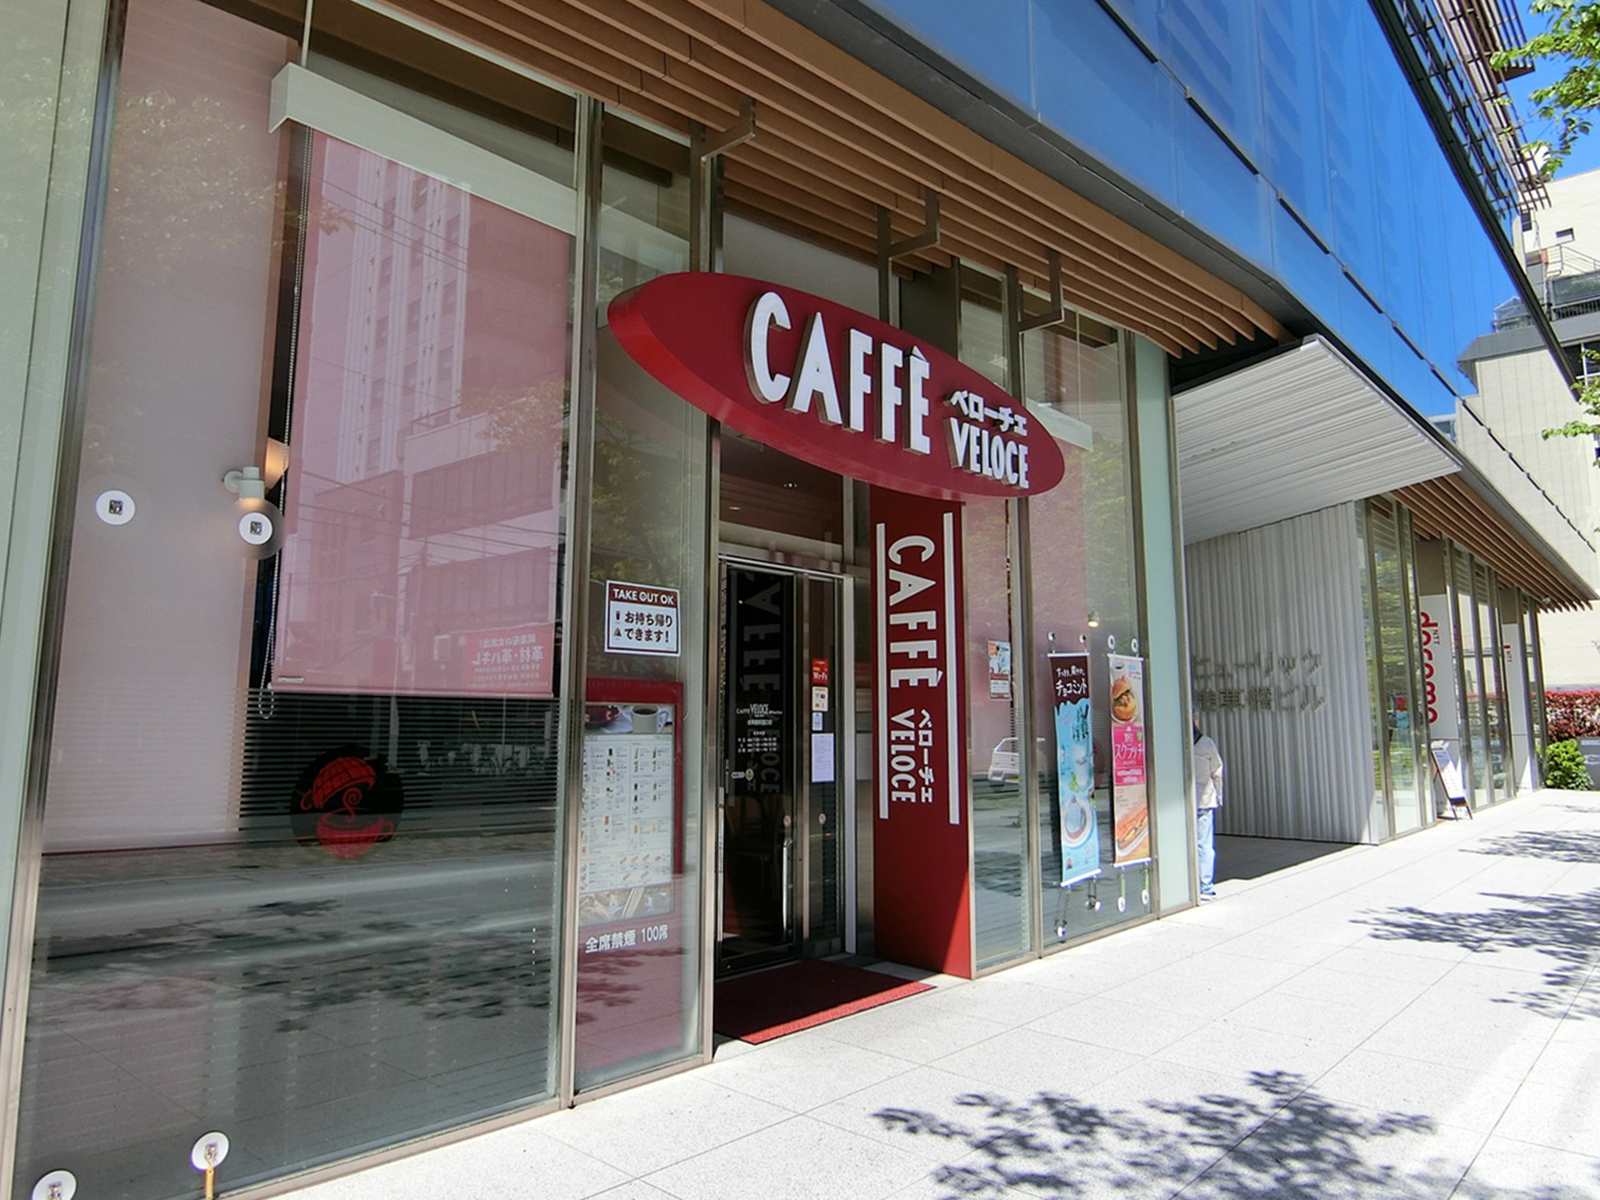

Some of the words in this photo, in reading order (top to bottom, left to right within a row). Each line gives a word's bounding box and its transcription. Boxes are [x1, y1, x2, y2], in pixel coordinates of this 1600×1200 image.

[948, 390, 1028, 436] ベローチェ
[948, 417, 1030, 489] VELOCE
[613, 589, 638, 601] TAKE
[639, 591, 659, 603] OUT
[660, 594, 674, 605] OK
[624, 611, 673, 628] お持ち帰り
[1055, 677, 1088, 697] チョコミント
[891, 708, 917, 803] VELOCE
[917, 708, 935, 803] ベローチェ
[585, 929, 636, 953] 全席禁煙
[641, 924, 669, 942] 100席
